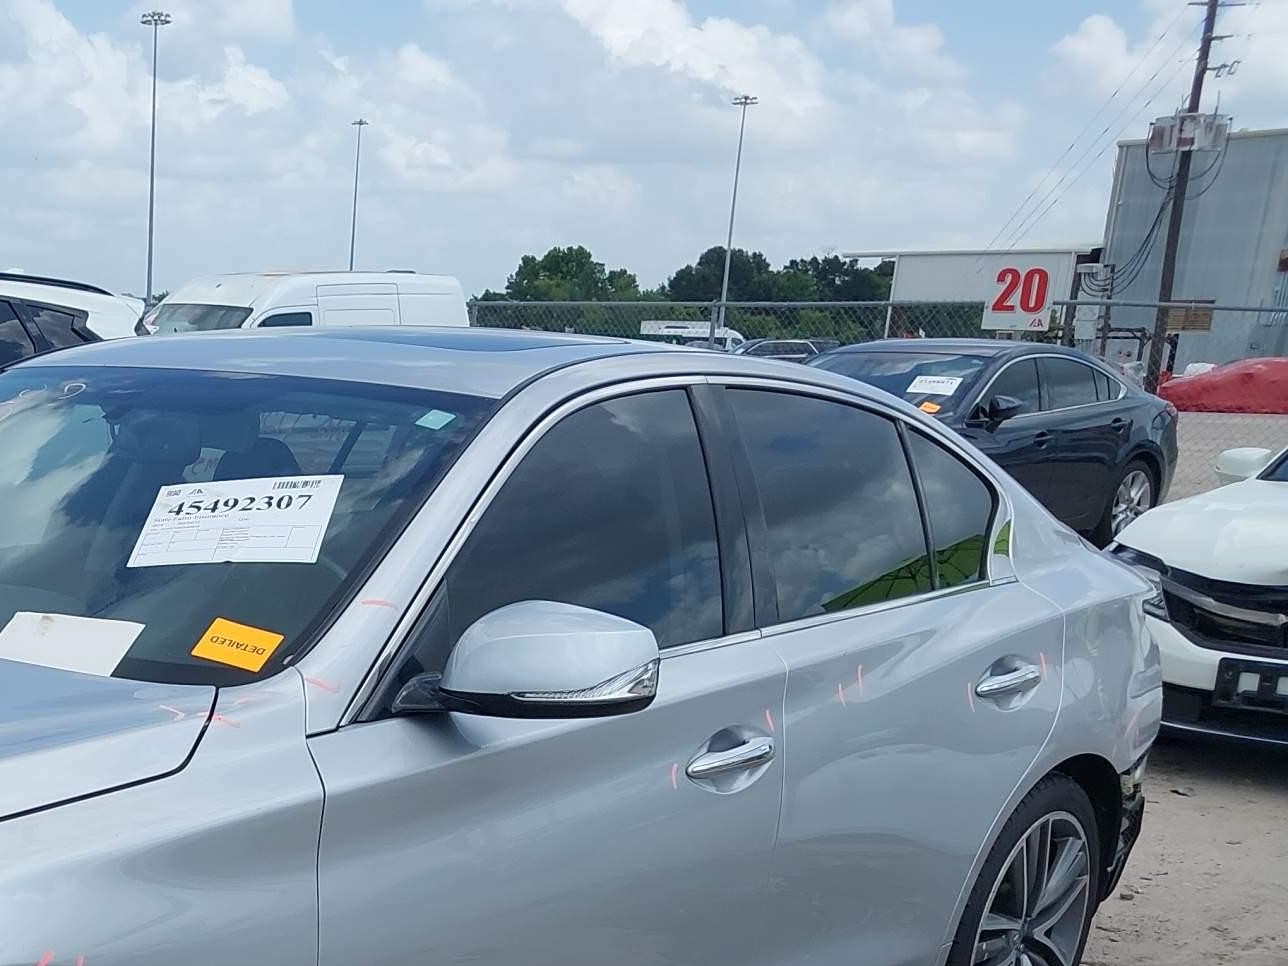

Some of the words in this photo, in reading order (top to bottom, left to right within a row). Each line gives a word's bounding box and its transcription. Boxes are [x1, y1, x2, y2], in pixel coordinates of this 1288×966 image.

[992, 267, 1049, 313] 20
[167, 494, 313, 516] 45492307
[210, 635, 266, 656] DETAILED
